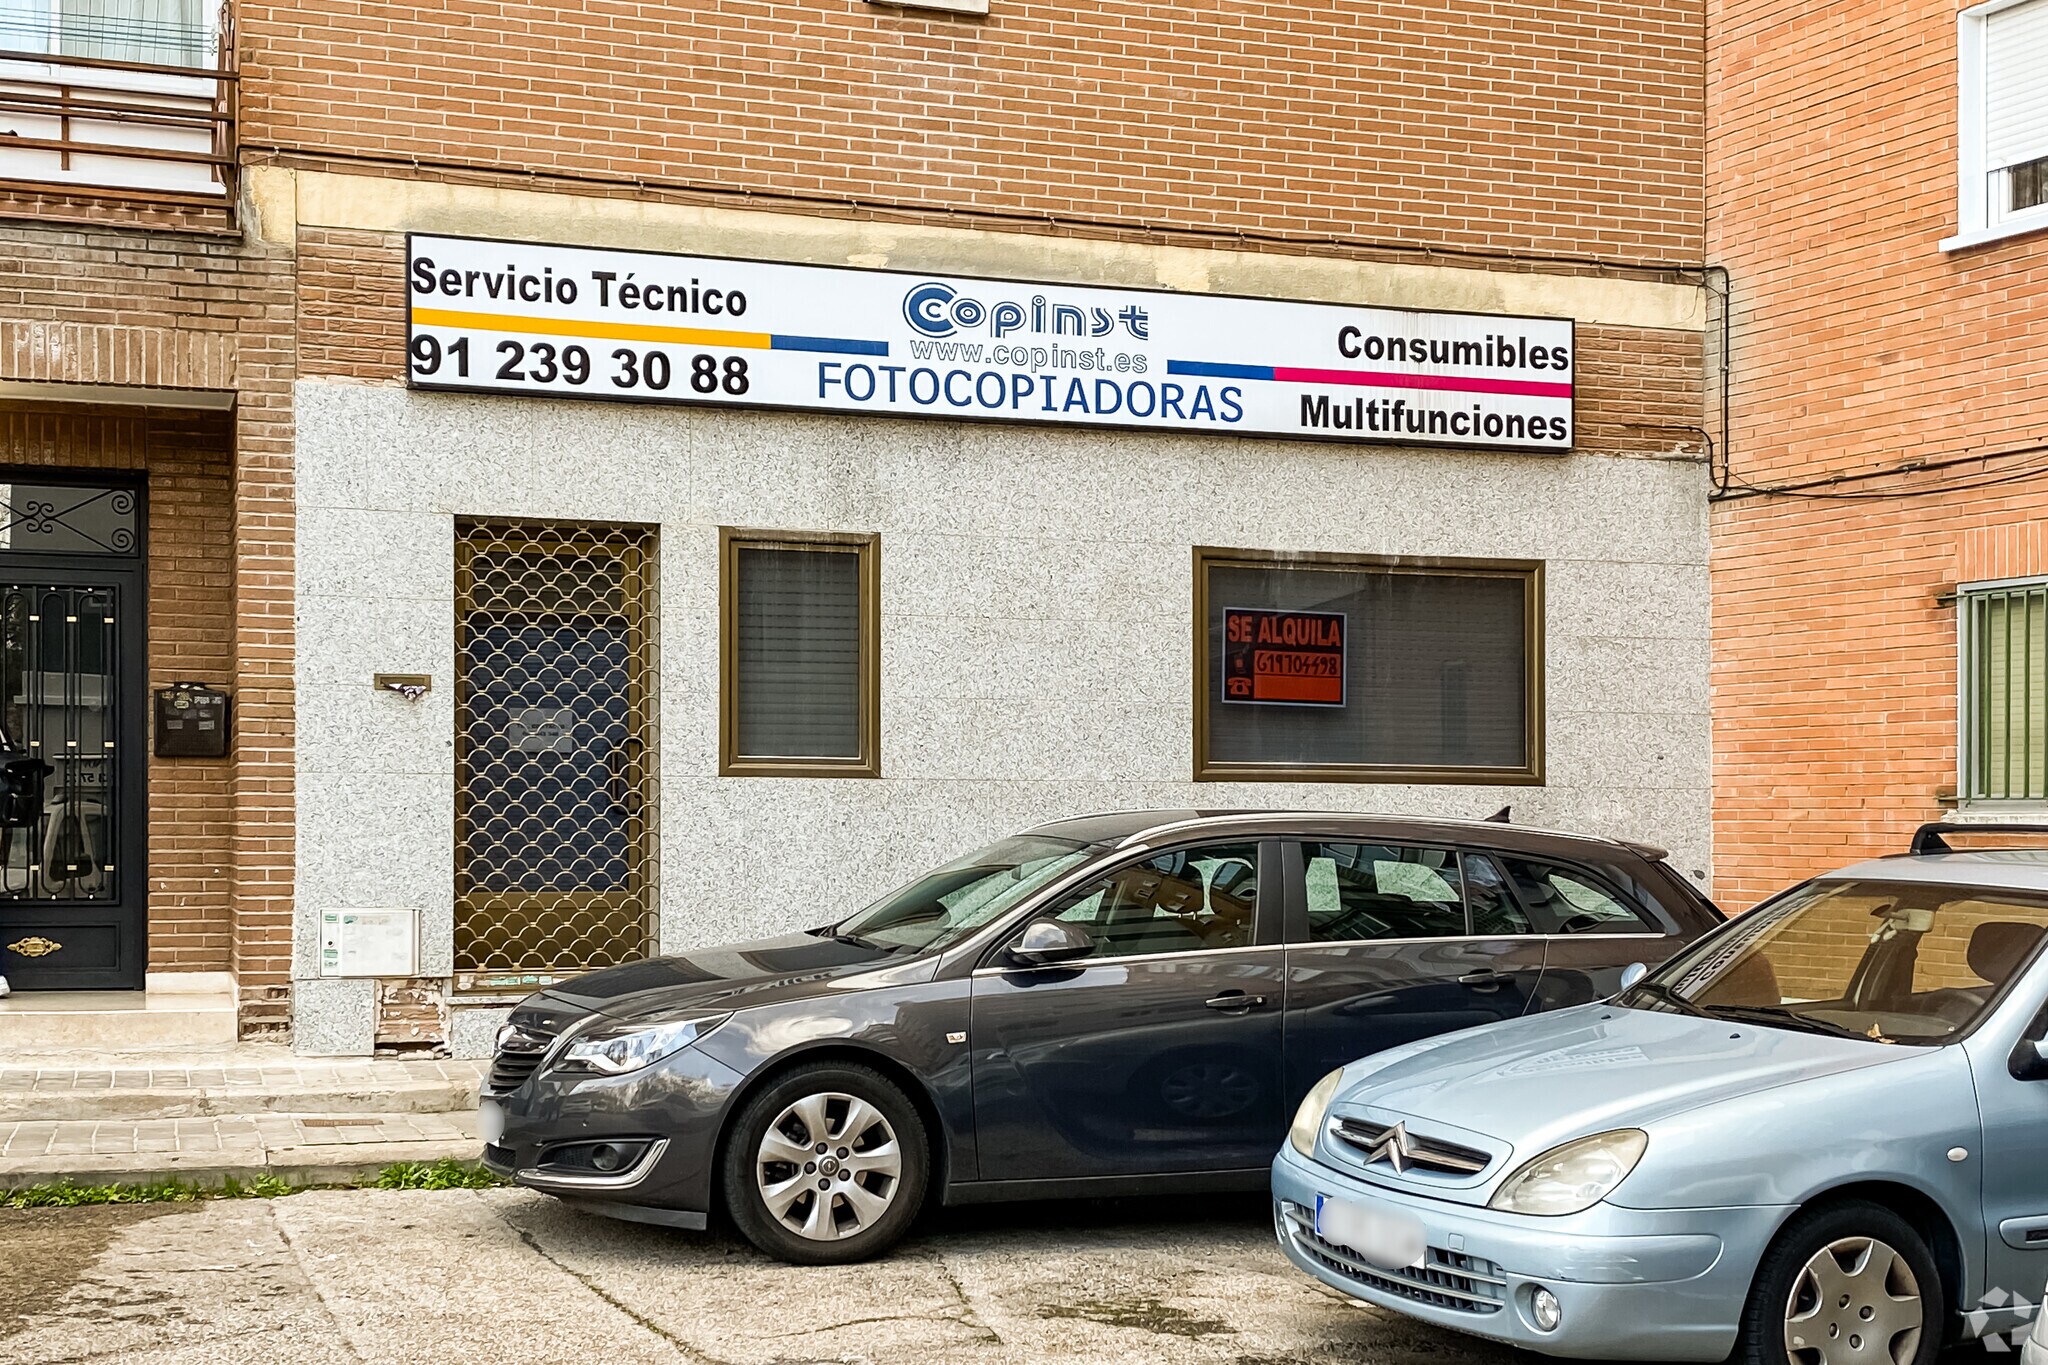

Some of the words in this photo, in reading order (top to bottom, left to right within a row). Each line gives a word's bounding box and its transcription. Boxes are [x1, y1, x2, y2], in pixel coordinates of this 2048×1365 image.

[411, 257, 578, 305] Servicio
[592, 271, 747, 317] Técnico
[902, 282, 1149, 340] Copinst
[411, 334, 469, 378] 91
[495, 340, 591, 386] 239
[611, 348, 671, 391] 30
[690, 354, 750, 396] 88
[909, 339, 1149, 374] www.copinst.es
[1338, 325, 1569, 371] Consumibles
[818, 362, 1244, 423] FOTOCOPIADORAS
[1300, 394, 1567, 441] Multifunciones
[1228, 615, 1253, 643] SE
[1257, 616, 1342, 647] ALQUILA
